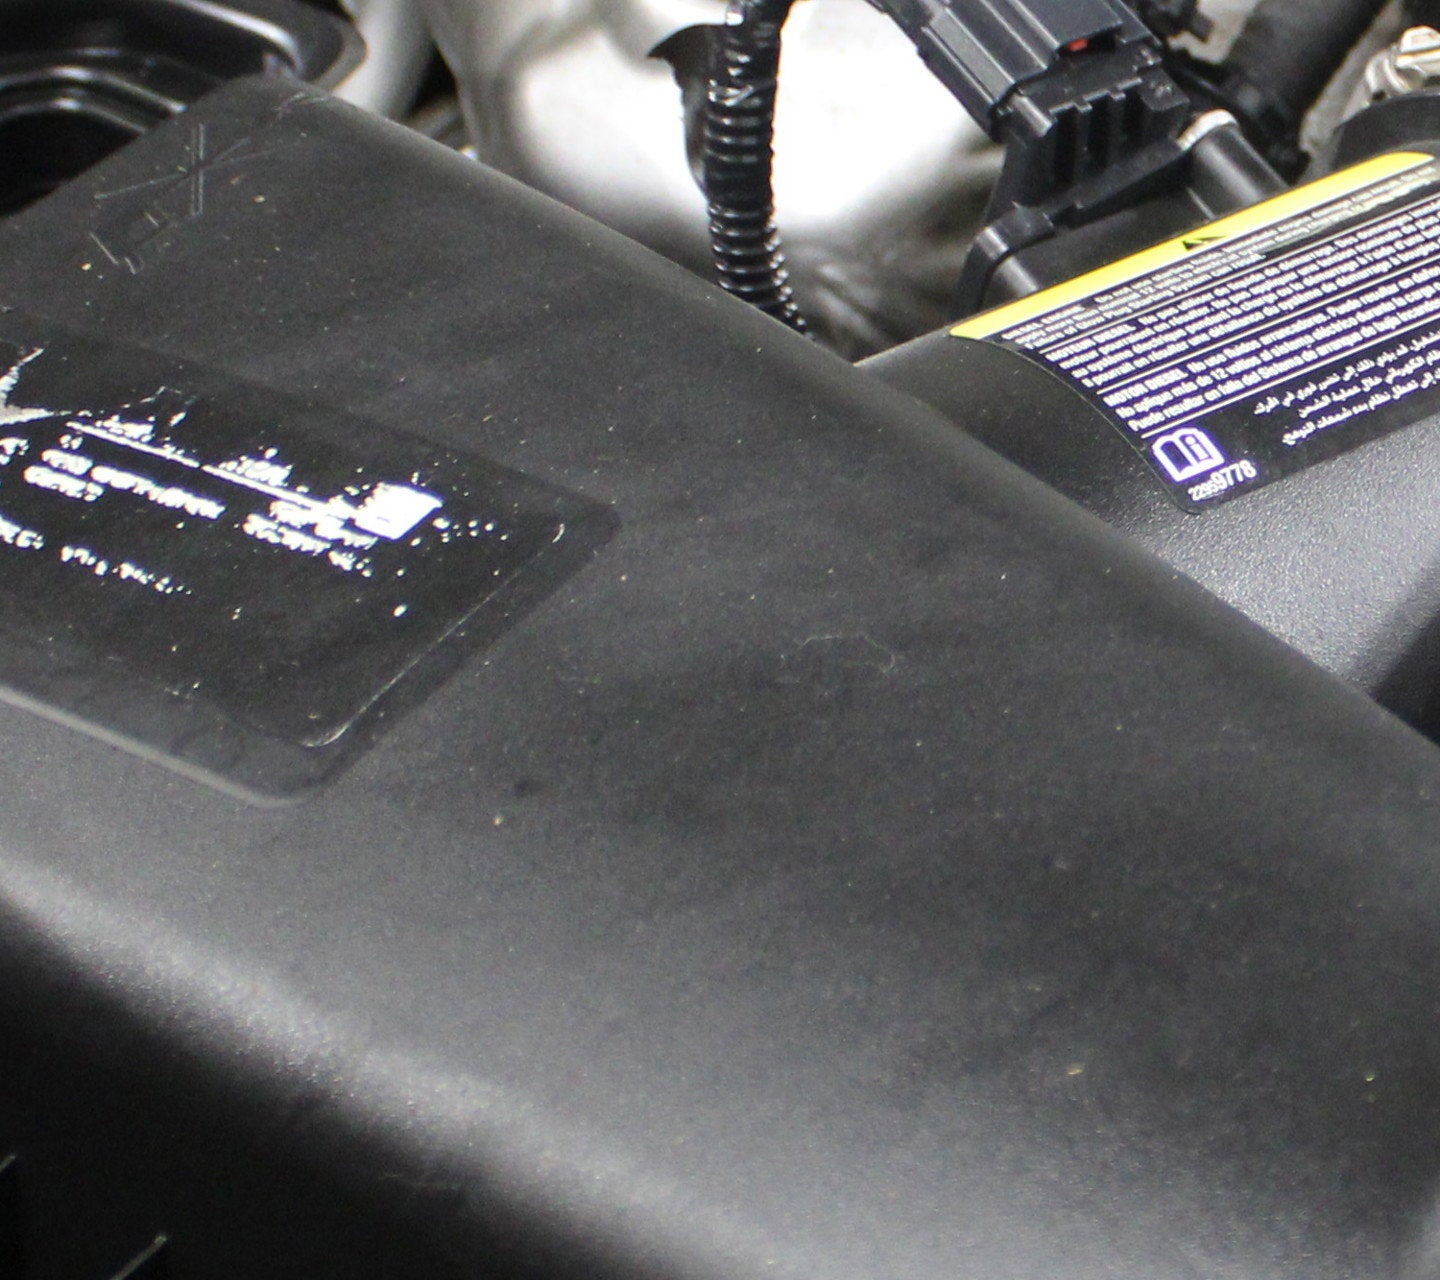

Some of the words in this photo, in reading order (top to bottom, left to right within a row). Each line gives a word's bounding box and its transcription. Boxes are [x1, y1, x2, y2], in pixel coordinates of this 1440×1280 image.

[1132, 357, 1150, 367] en
[1187, 332, 1210, 345] une
[1262, 302, 1280, 316] du
[1320, 282, 1337, 292] de
[1153, 322, 1170, 332] en
[1228, 290, 1251, 303] pas
[1398, 223, 1417, 234] de
[1414, 215, 1439, 229] plus
[1226, 306, 1242, 316] la
[1276, 284, 1293, 296] ou
[1288, 282, 1304, 291] le
[1103, 383, 1148, 405] MOTOR
[1186, 361, 1206, 373] No
[1203, 353, 1226, 366] use
[1326, 299, 1361, 316] Puede
[1397, 277, 1414, 288] en
[1115, 406, 1135, 418] No
[1133, 391, 1173, 412] aplique
[1170, 381, 1197, 396] más
[1195, 375, 1213, 386] de
[1210, 367, 1228, 380] 12
[1225, 356, 1261, 374] voltios
[1259, 349, 1273, 361] al
[1270, 334, 1314, 356] sistema
[1391, 296, 1407, 306] la
[1404, 285, 1436, 302] carga
[1128, 411, 1164, 430] Puede
[1162, 395, 1204, 417] resultar
[1203, 388, 1221, 401] en
[1241, 371, 1261, 385] del
[1257, 355, 1304, 378] Sistema
[1300, 349, 1317, 361] de
[1312, 331, 1362, 355] arranque
[1359, 325, 1377, 337] de
[1188, 460, 1257, 500] 22959778
